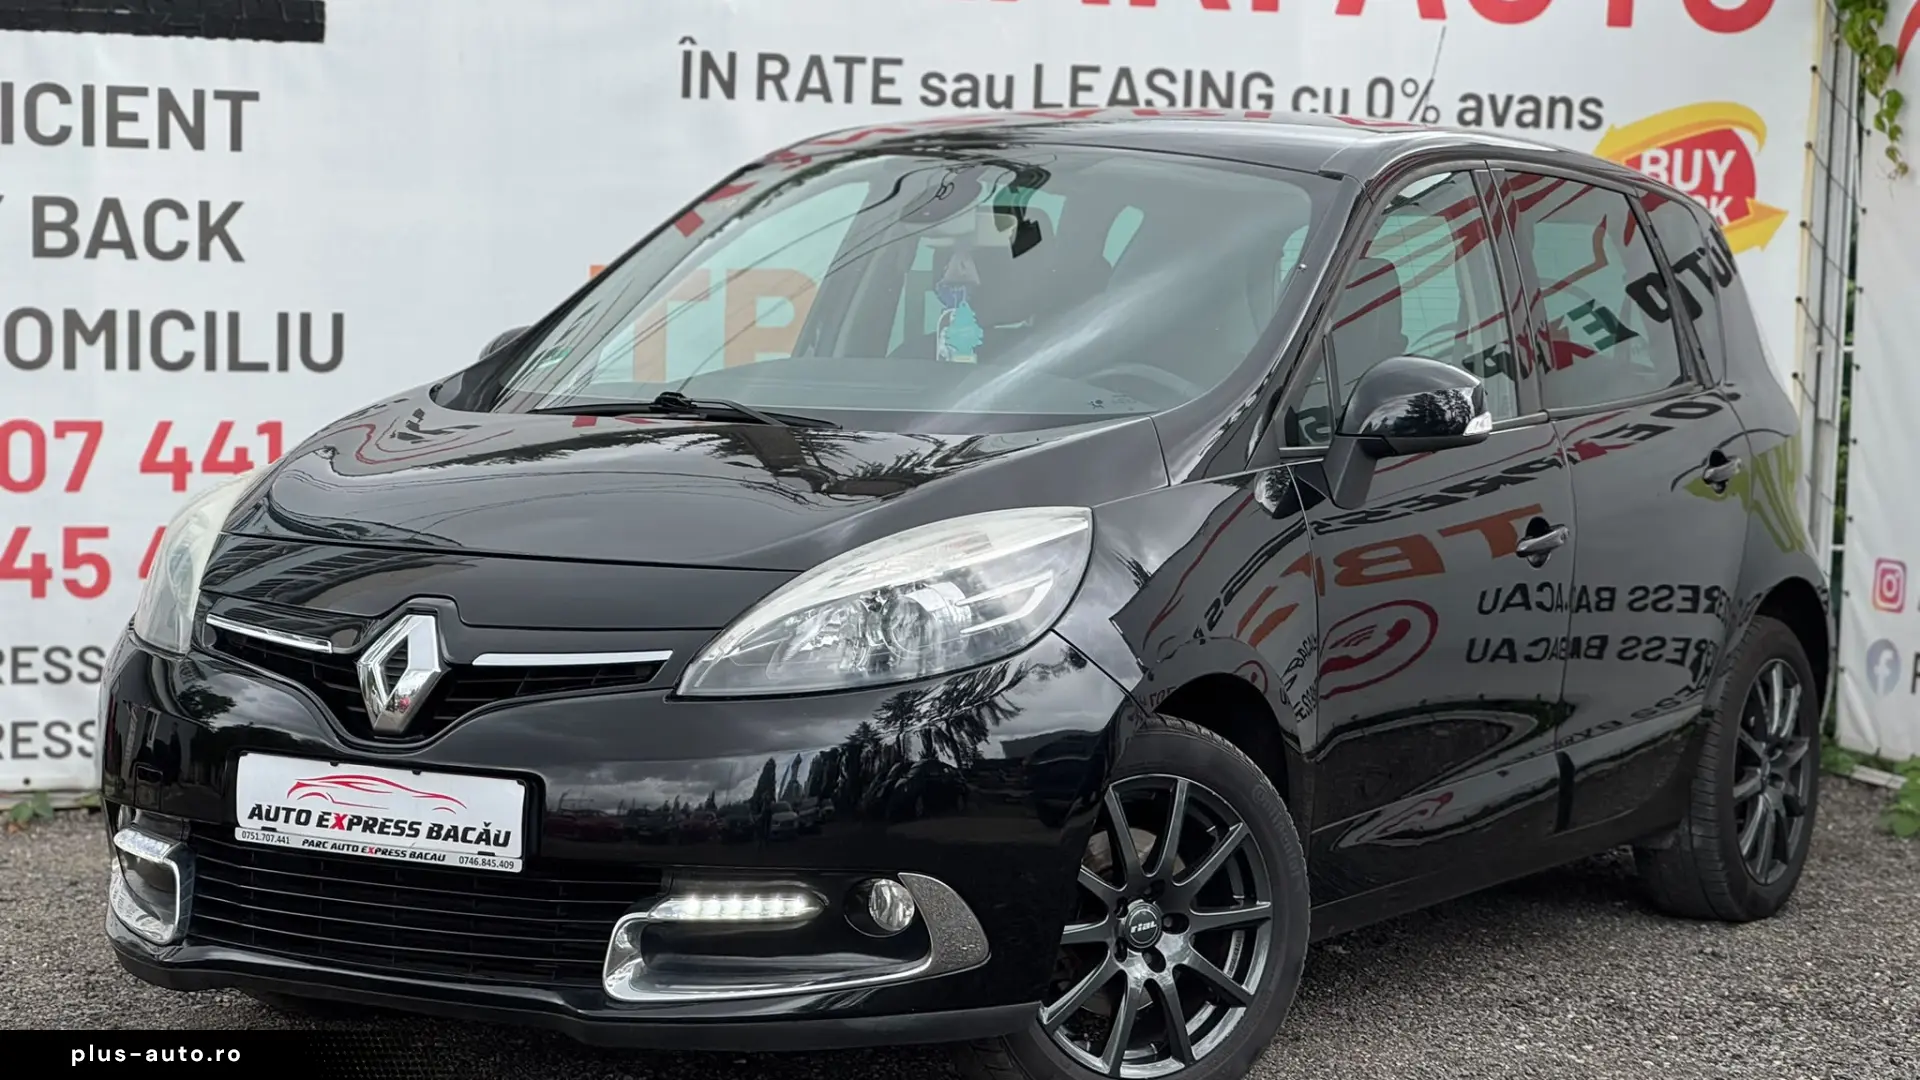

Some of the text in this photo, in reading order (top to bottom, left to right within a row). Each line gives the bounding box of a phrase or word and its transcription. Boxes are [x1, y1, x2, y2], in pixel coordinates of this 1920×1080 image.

[678, 36, 737, 101] ÎN
[755, 52, 904, 105] RATE
[919, 70, 1015, 109] sau
[1033, 63, 1275, 109] LEASING
[1291, 83, 1350, 116] cu
[1456, 93, 1605, 131] avans
[1640, 148, 1737, 192] BUY
[31, 195, 246, 262] BACK
[3, 307, 345, 373] OMICILIU
[0, 645, 105, 685] ESS
[0, 720, 95, 760] ESS
[248, 803, 512, 848] AUTO EXPRESS BACĂU
[302, 838, 446, 863] PARC AUTO EXPRESS BACAU
